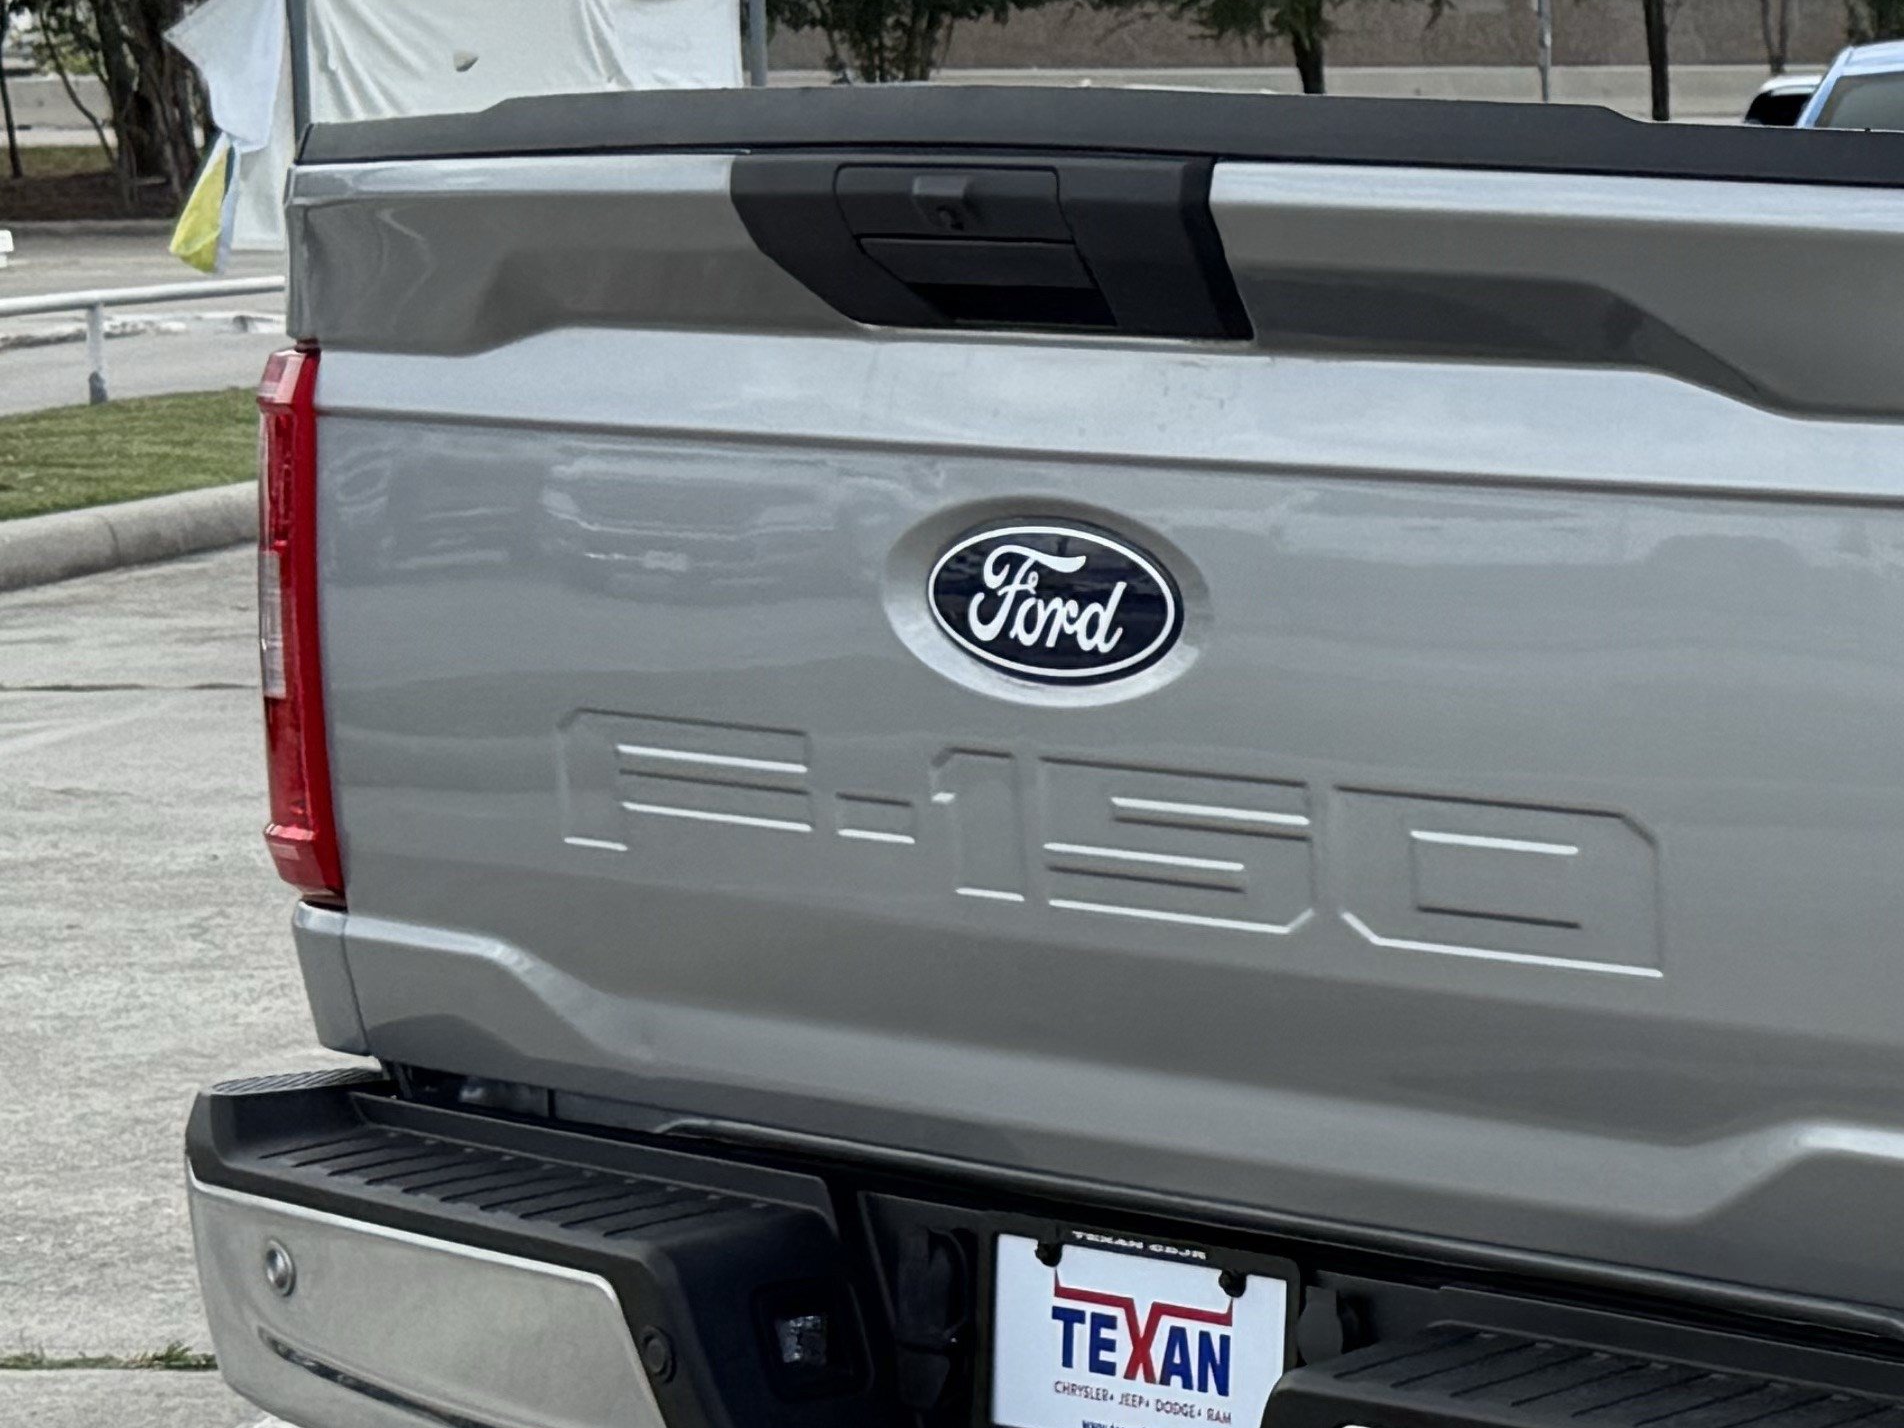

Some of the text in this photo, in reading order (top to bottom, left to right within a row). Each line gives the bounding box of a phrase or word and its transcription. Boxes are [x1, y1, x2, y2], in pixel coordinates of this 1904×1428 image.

[968, 544, 1127, 653] Ford
[557, 707, 1664, 978] F-150
[1072, 1230, 1144, 1249] TEXAN
[1051, 1288, 1232, 1397] TEXAN
[1155, 1398, 1196, 1419] DODGE
[1206, 1407, 1232, 1425] RAM
